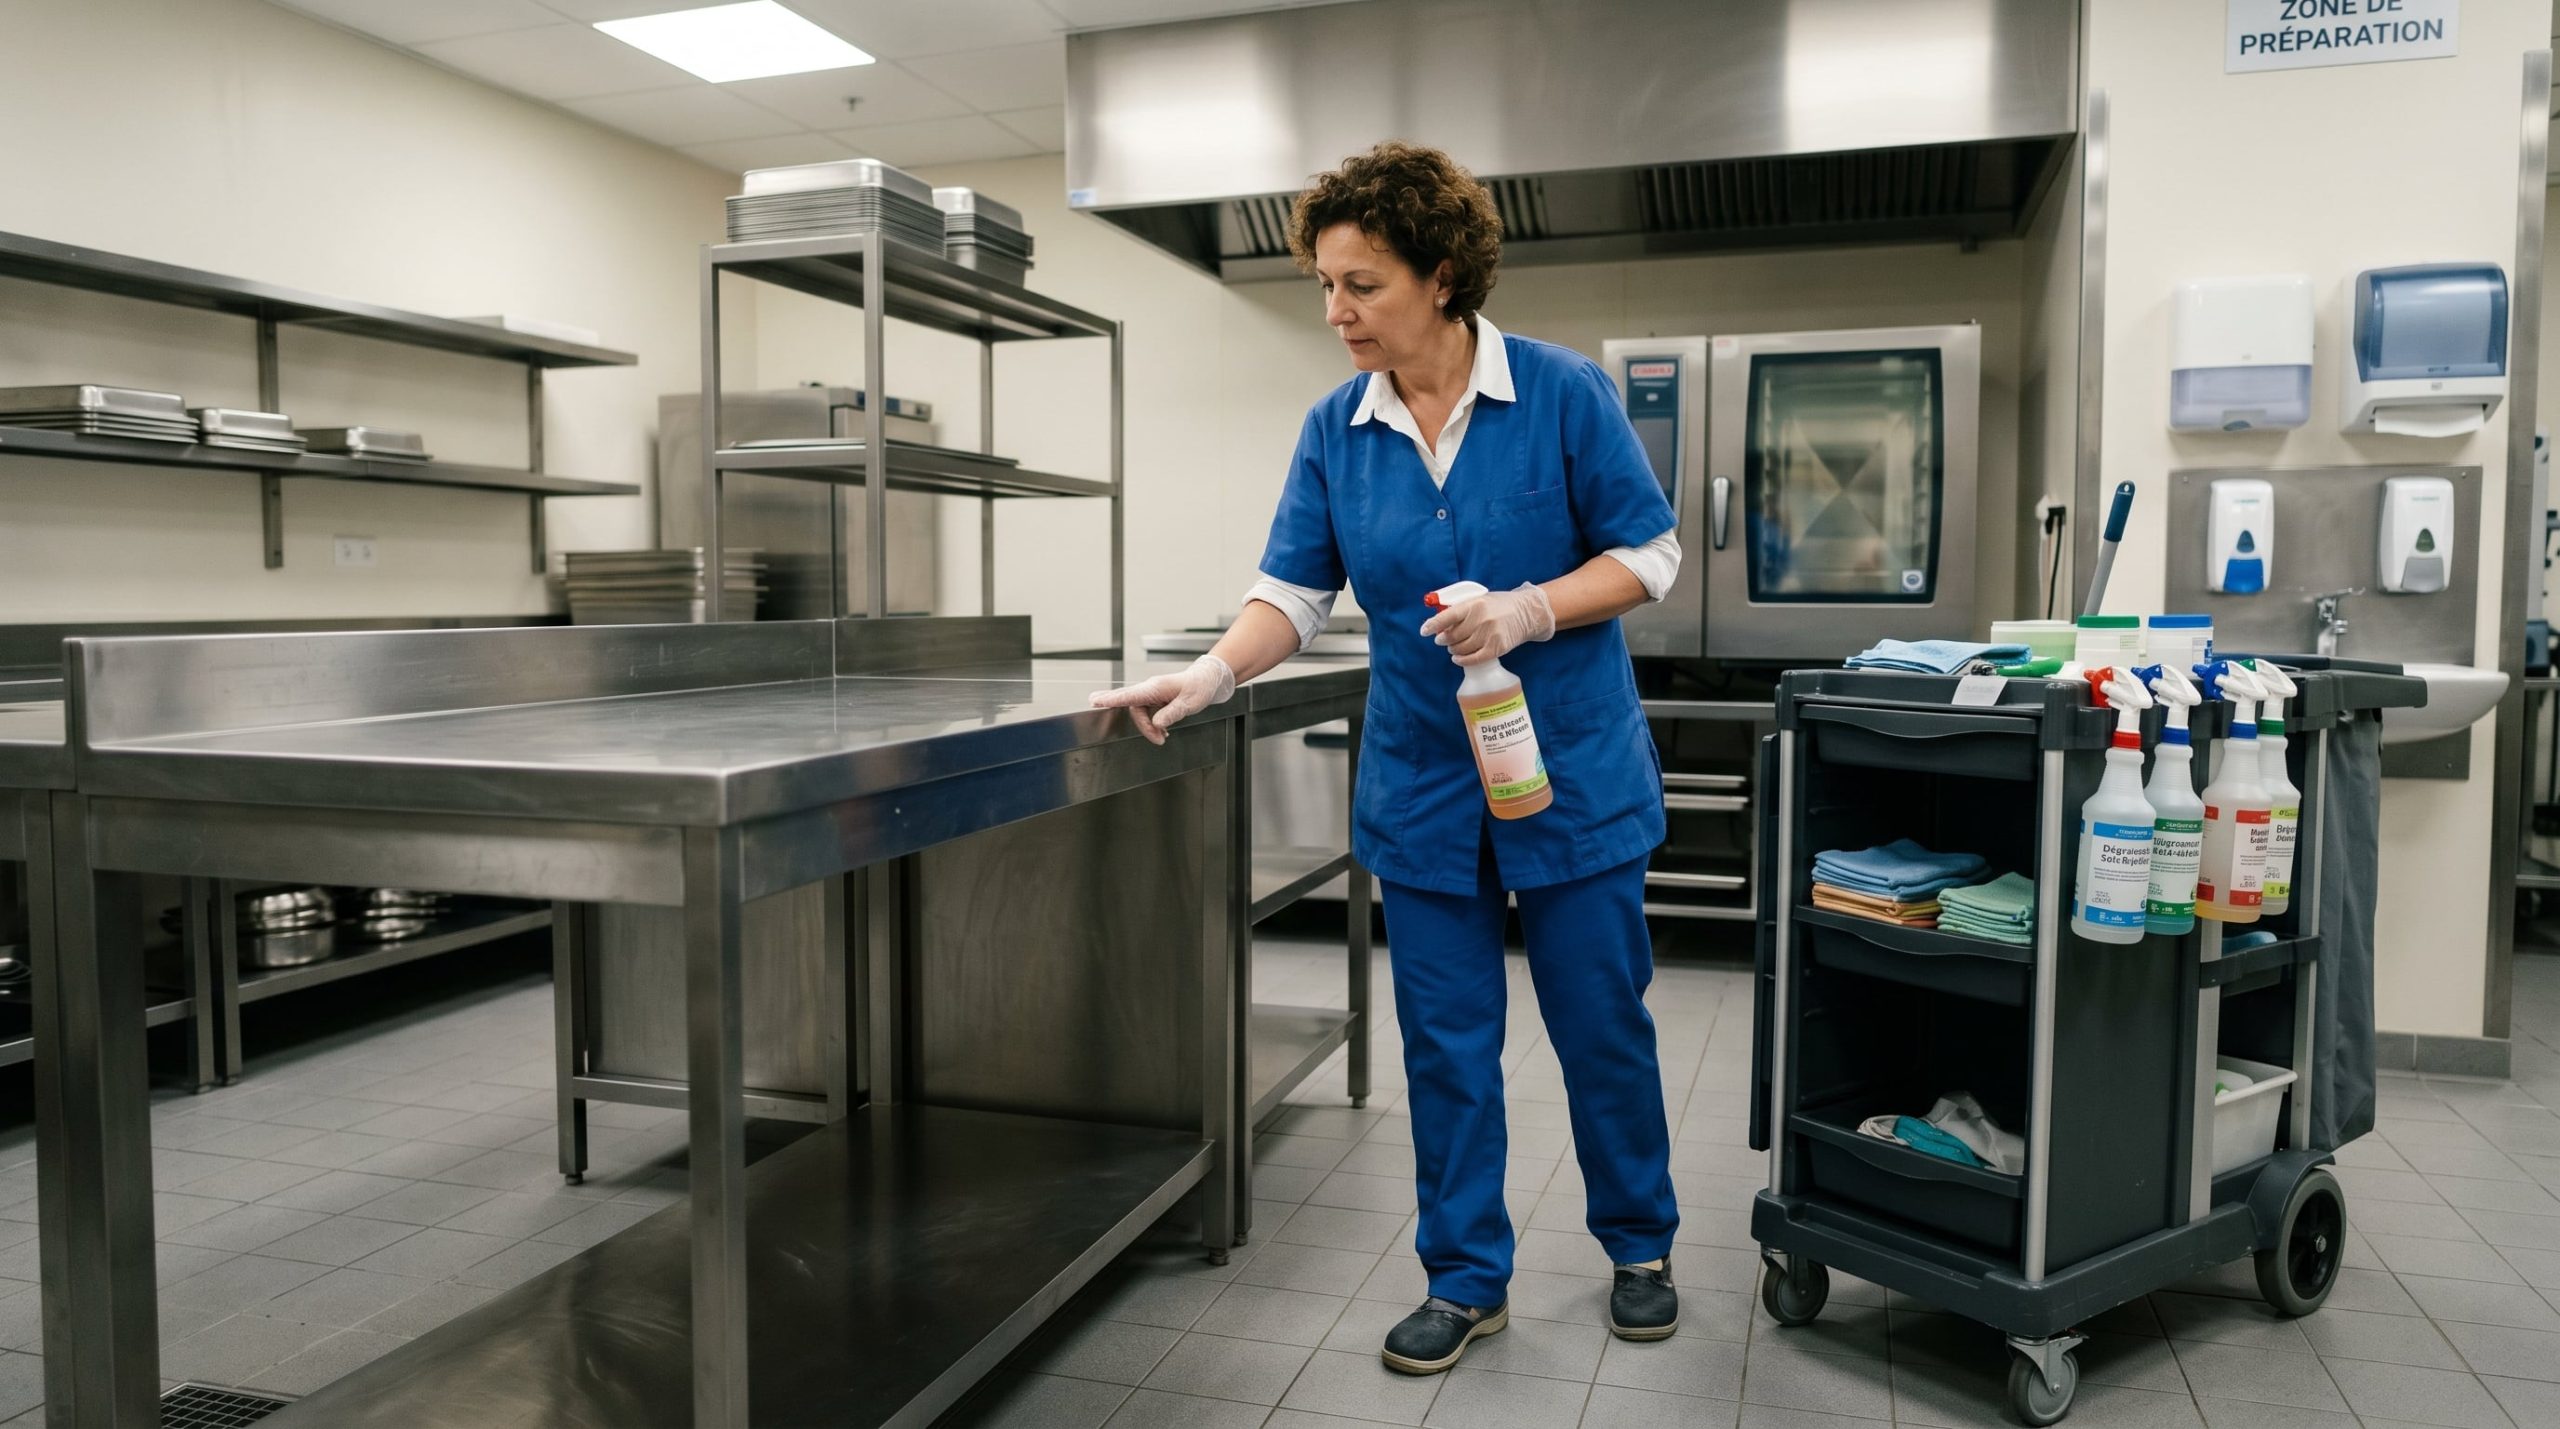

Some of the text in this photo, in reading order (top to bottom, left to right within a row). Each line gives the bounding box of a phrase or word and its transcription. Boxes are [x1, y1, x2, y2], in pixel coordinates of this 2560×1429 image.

[2280, 0, 2403, 20] ZONE DE
[2240, 19, 2443, 55] PRÉPARATION
